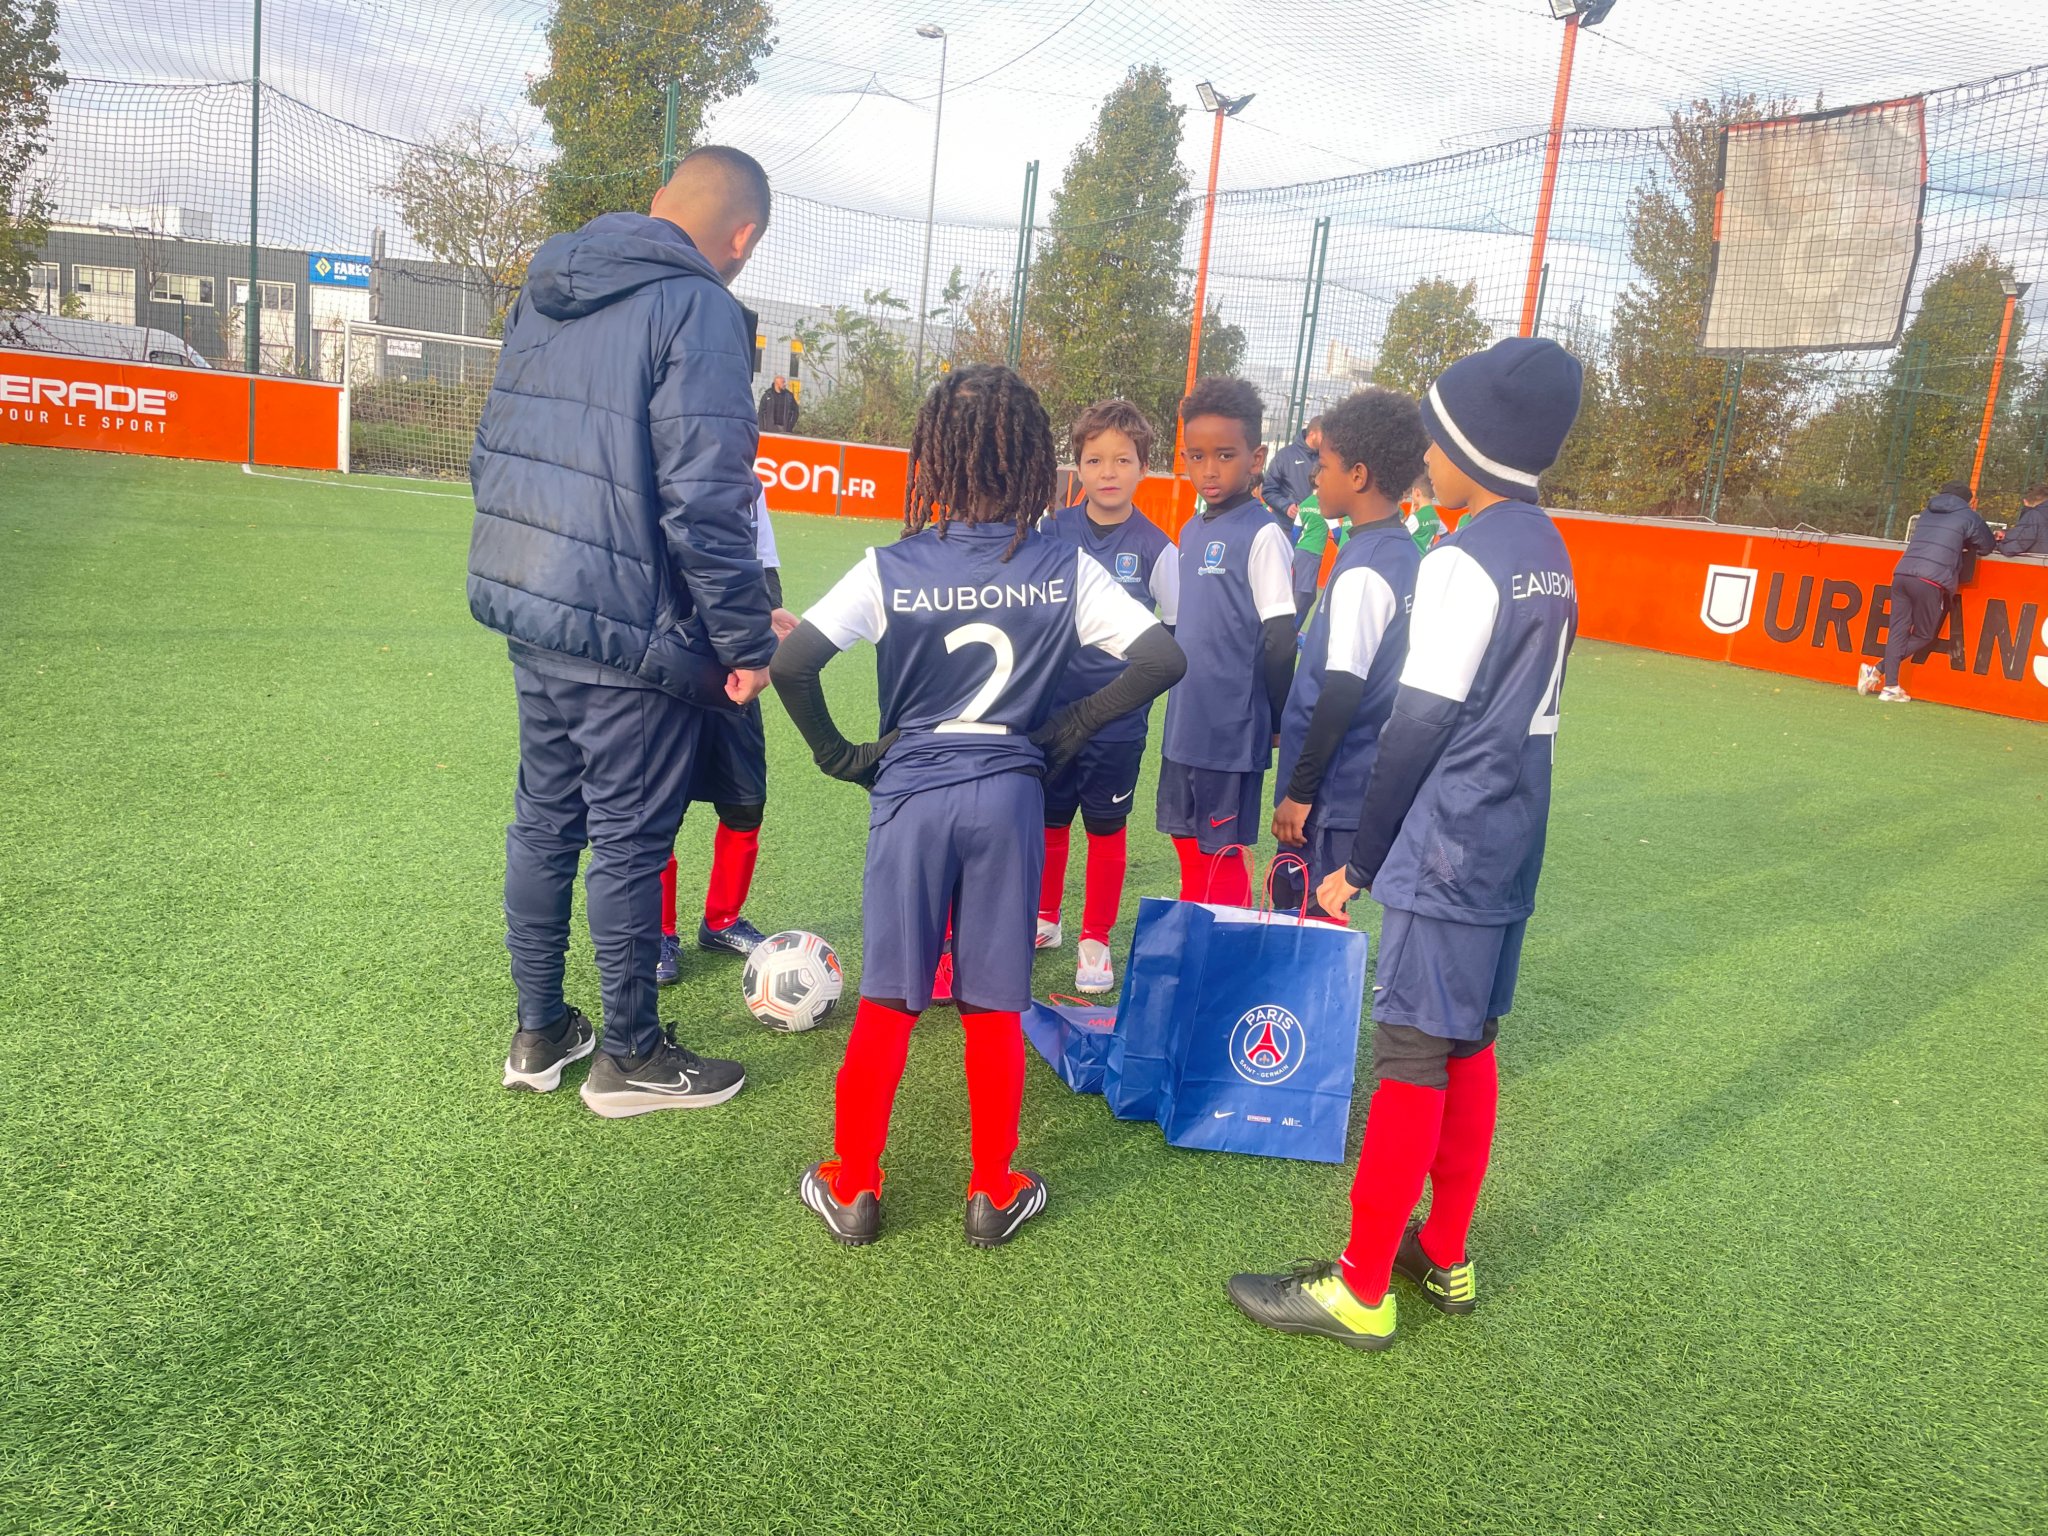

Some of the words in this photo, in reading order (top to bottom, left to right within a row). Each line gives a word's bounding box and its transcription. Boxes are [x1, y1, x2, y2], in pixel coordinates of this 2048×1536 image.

[65, 413, 86, 427] LE
[101, 416, 166, 434] SPORT
[893, 578, 1067, 612] EAUBONNE
[934, 622, 1013, 734] 2
[1245, 1009, 1294, 1030] PARIS
